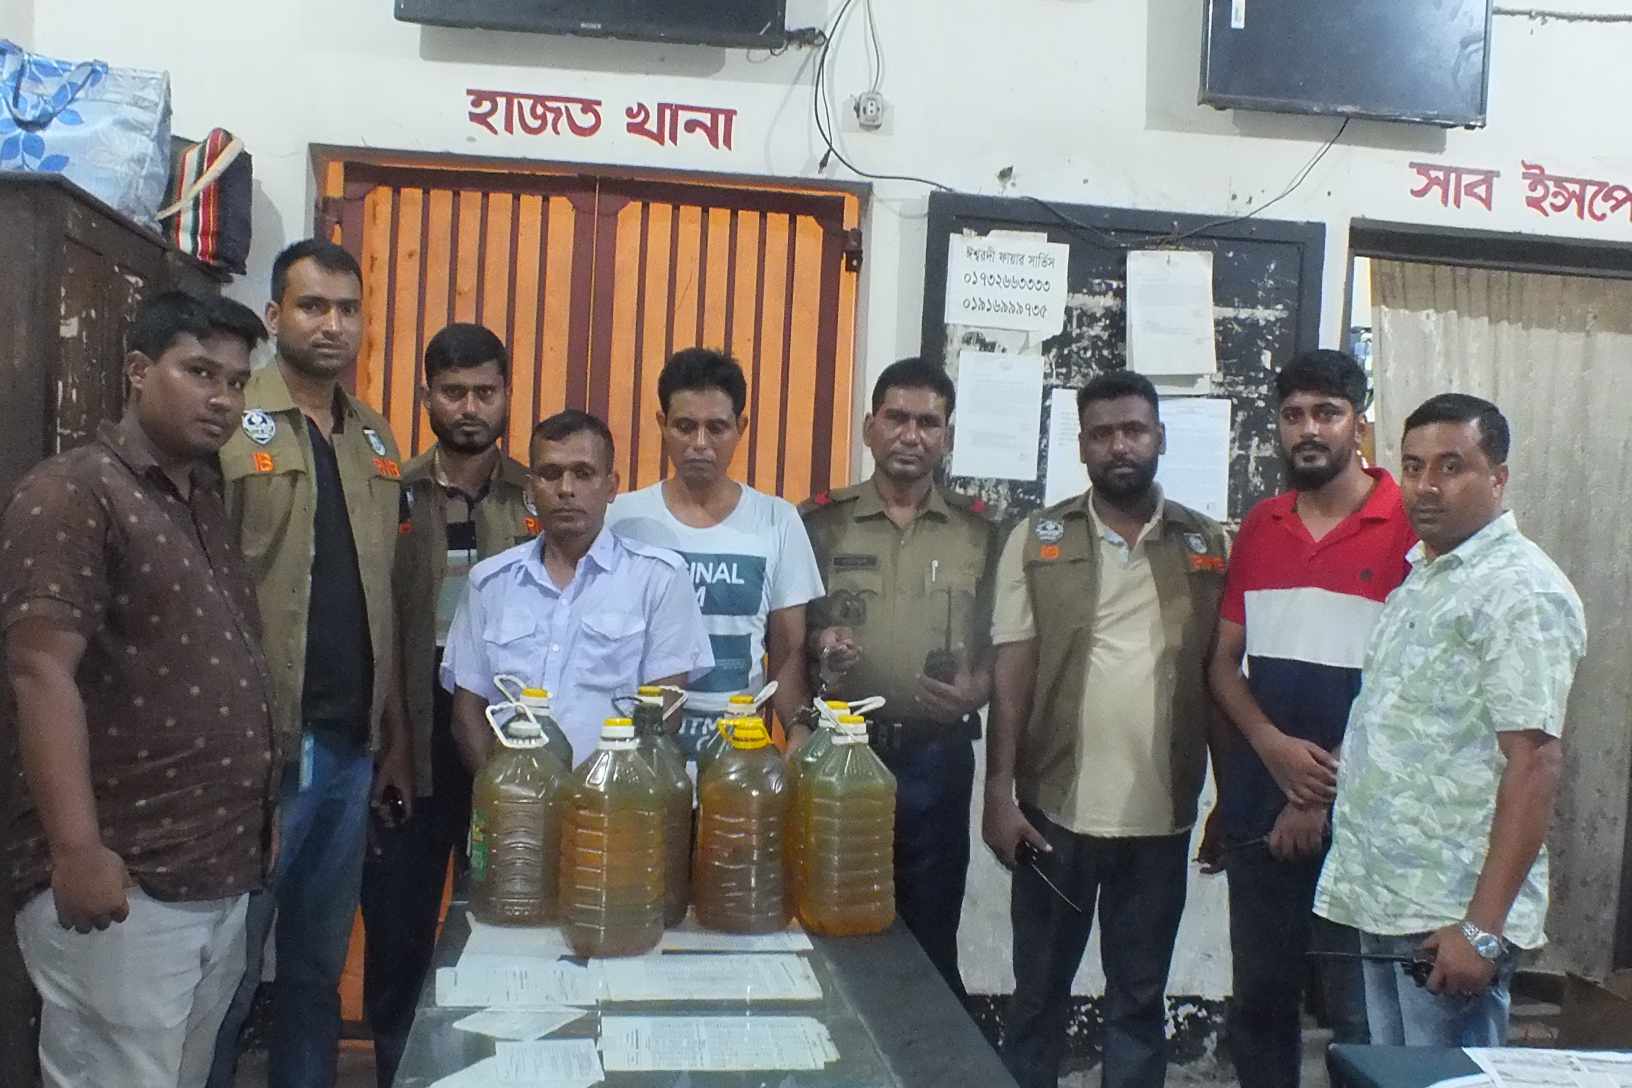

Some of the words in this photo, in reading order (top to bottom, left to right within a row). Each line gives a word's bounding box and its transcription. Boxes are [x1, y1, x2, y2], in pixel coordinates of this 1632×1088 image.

[466, 88, 602, 138] হাজত
[625, 102, 738, 152] খানা
[1409, 161, 1501, 212] সাব
